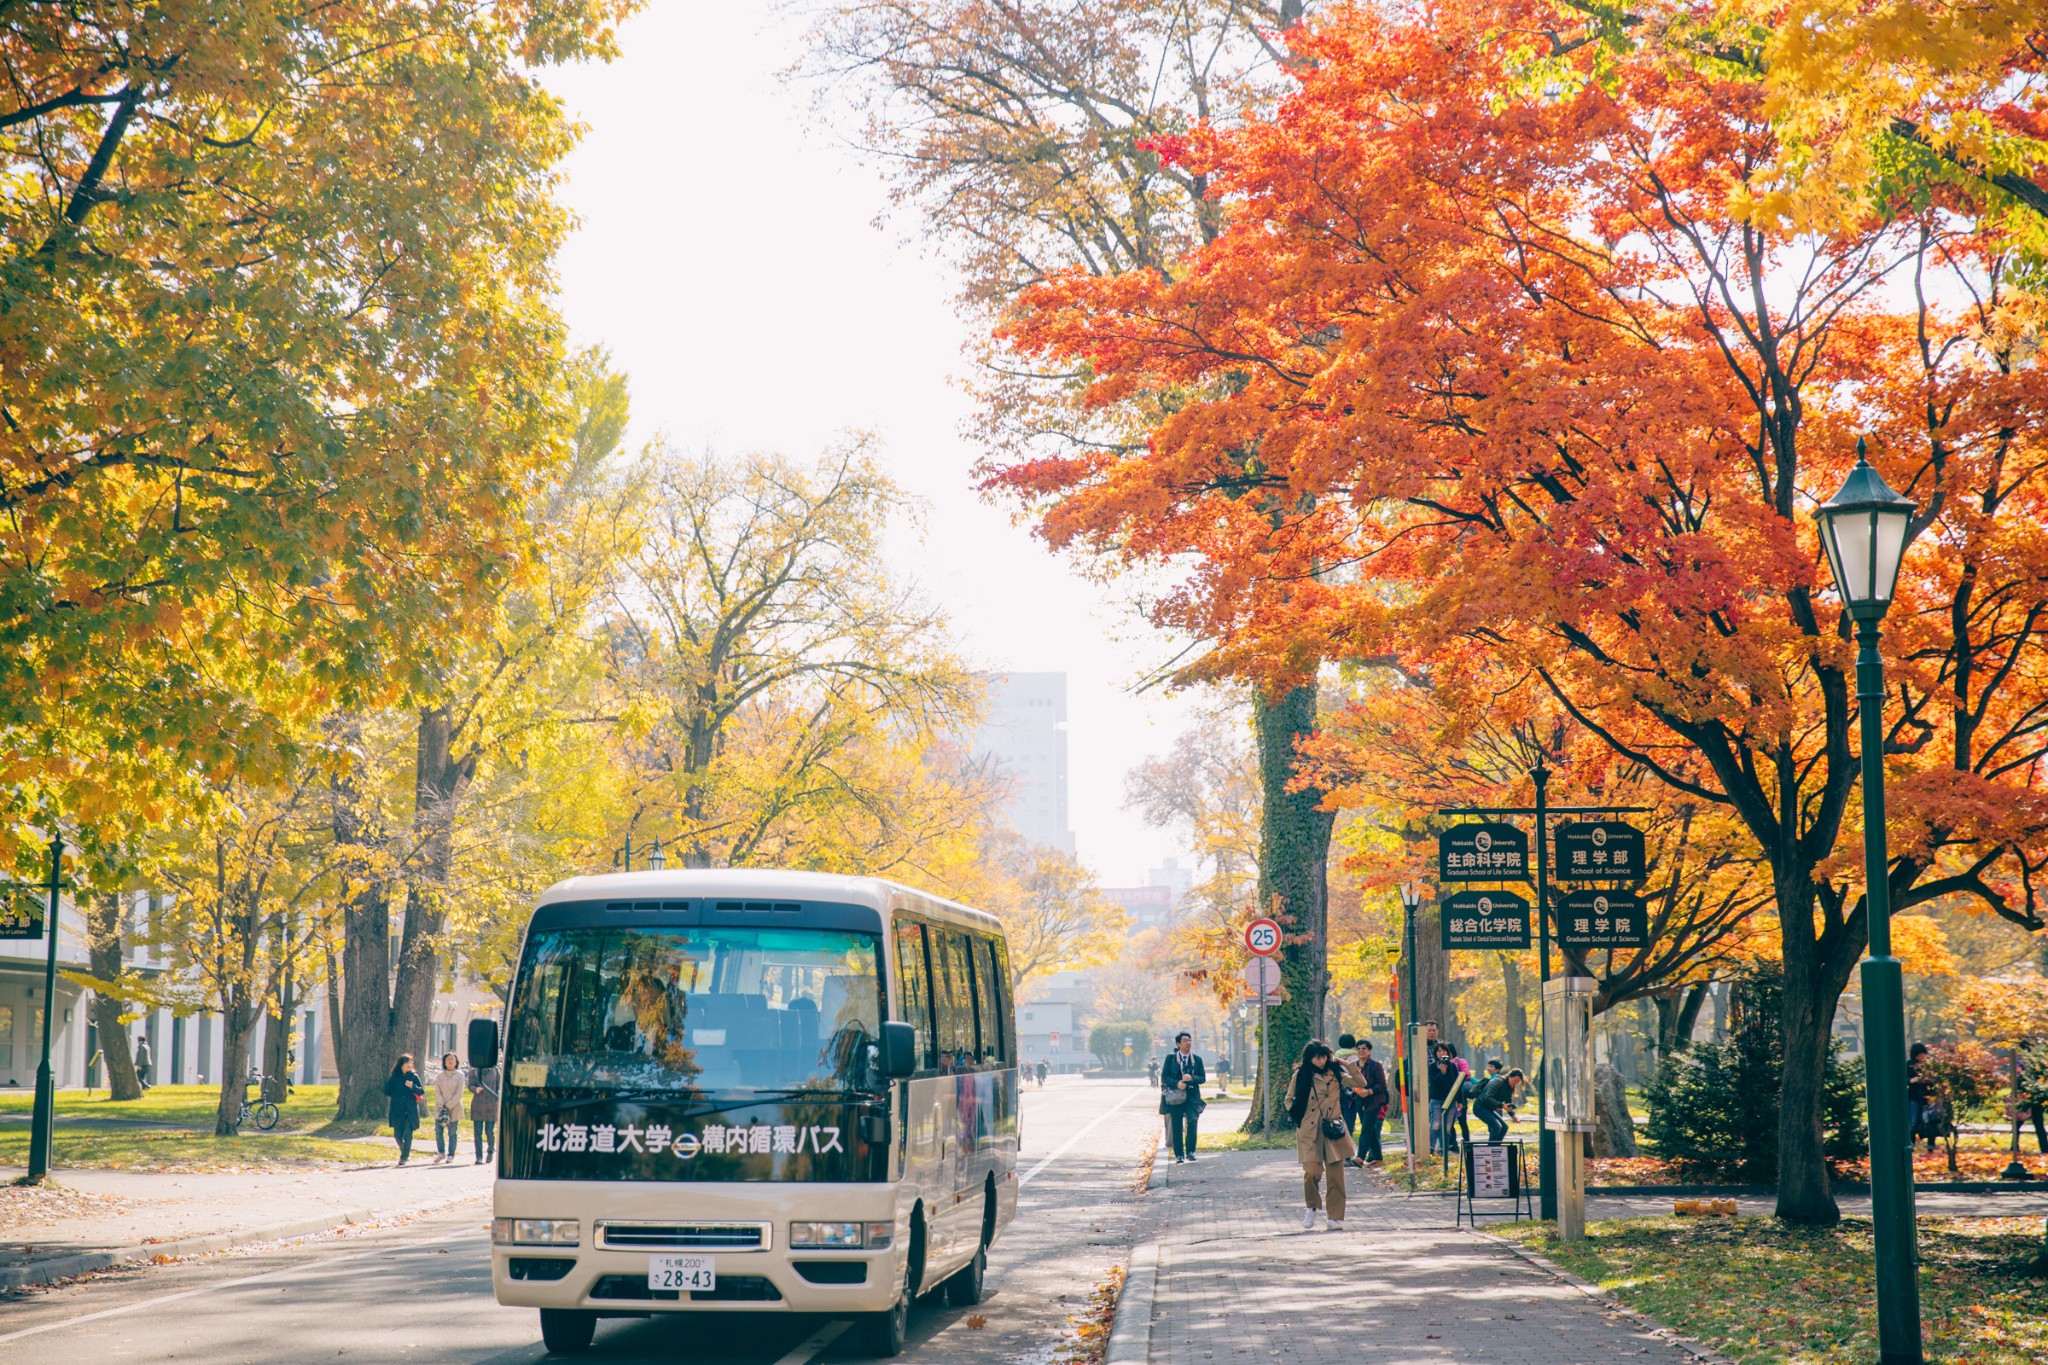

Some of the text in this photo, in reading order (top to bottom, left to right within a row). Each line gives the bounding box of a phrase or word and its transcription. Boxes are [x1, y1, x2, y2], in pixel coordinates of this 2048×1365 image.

[1447, 852, 1521, 867] 生命科学院
[1572, 850, 1628, 865] 理学部
[1449, 918, 1522, 933] 総合化学院
[1574, 918, 1631, 933] 理学院
[1253, 929, 1274, 945] 25
[536, 1124, 843, 1154] 北海道大学 構内循環バス
[654, 1270, 711, 1287] さ 28-43
